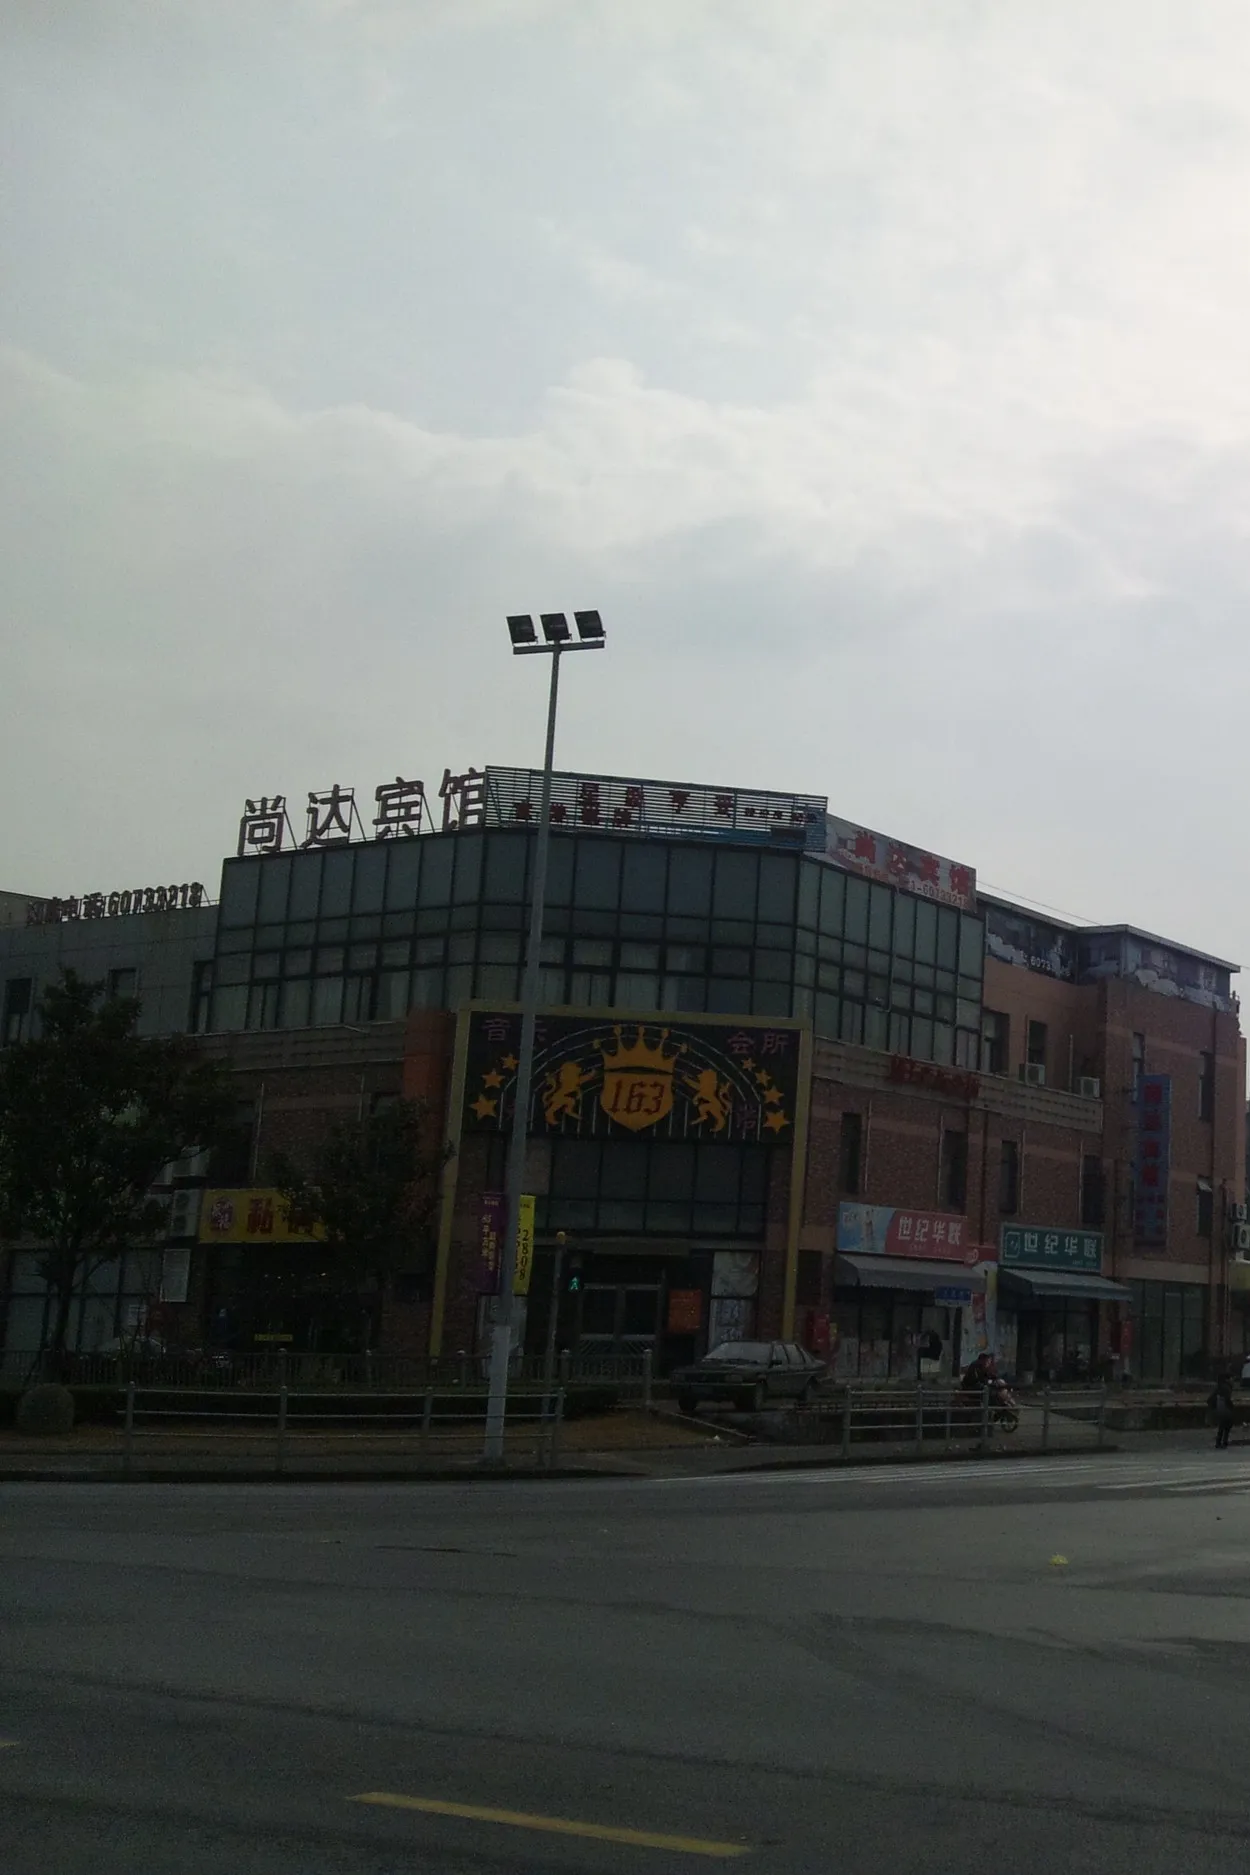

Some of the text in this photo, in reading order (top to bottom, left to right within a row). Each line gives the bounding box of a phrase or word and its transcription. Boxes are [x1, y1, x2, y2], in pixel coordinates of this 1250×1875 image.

[238, 767, 485, 856] 尚达宾馆
[727, 1031, 790, 1056] 会所
[611, 1080, 665, 1115] 163
[898, 1214, 962, 1246] 世纪华联
[1024, 1231, 1097, 1259] 世纪华联
